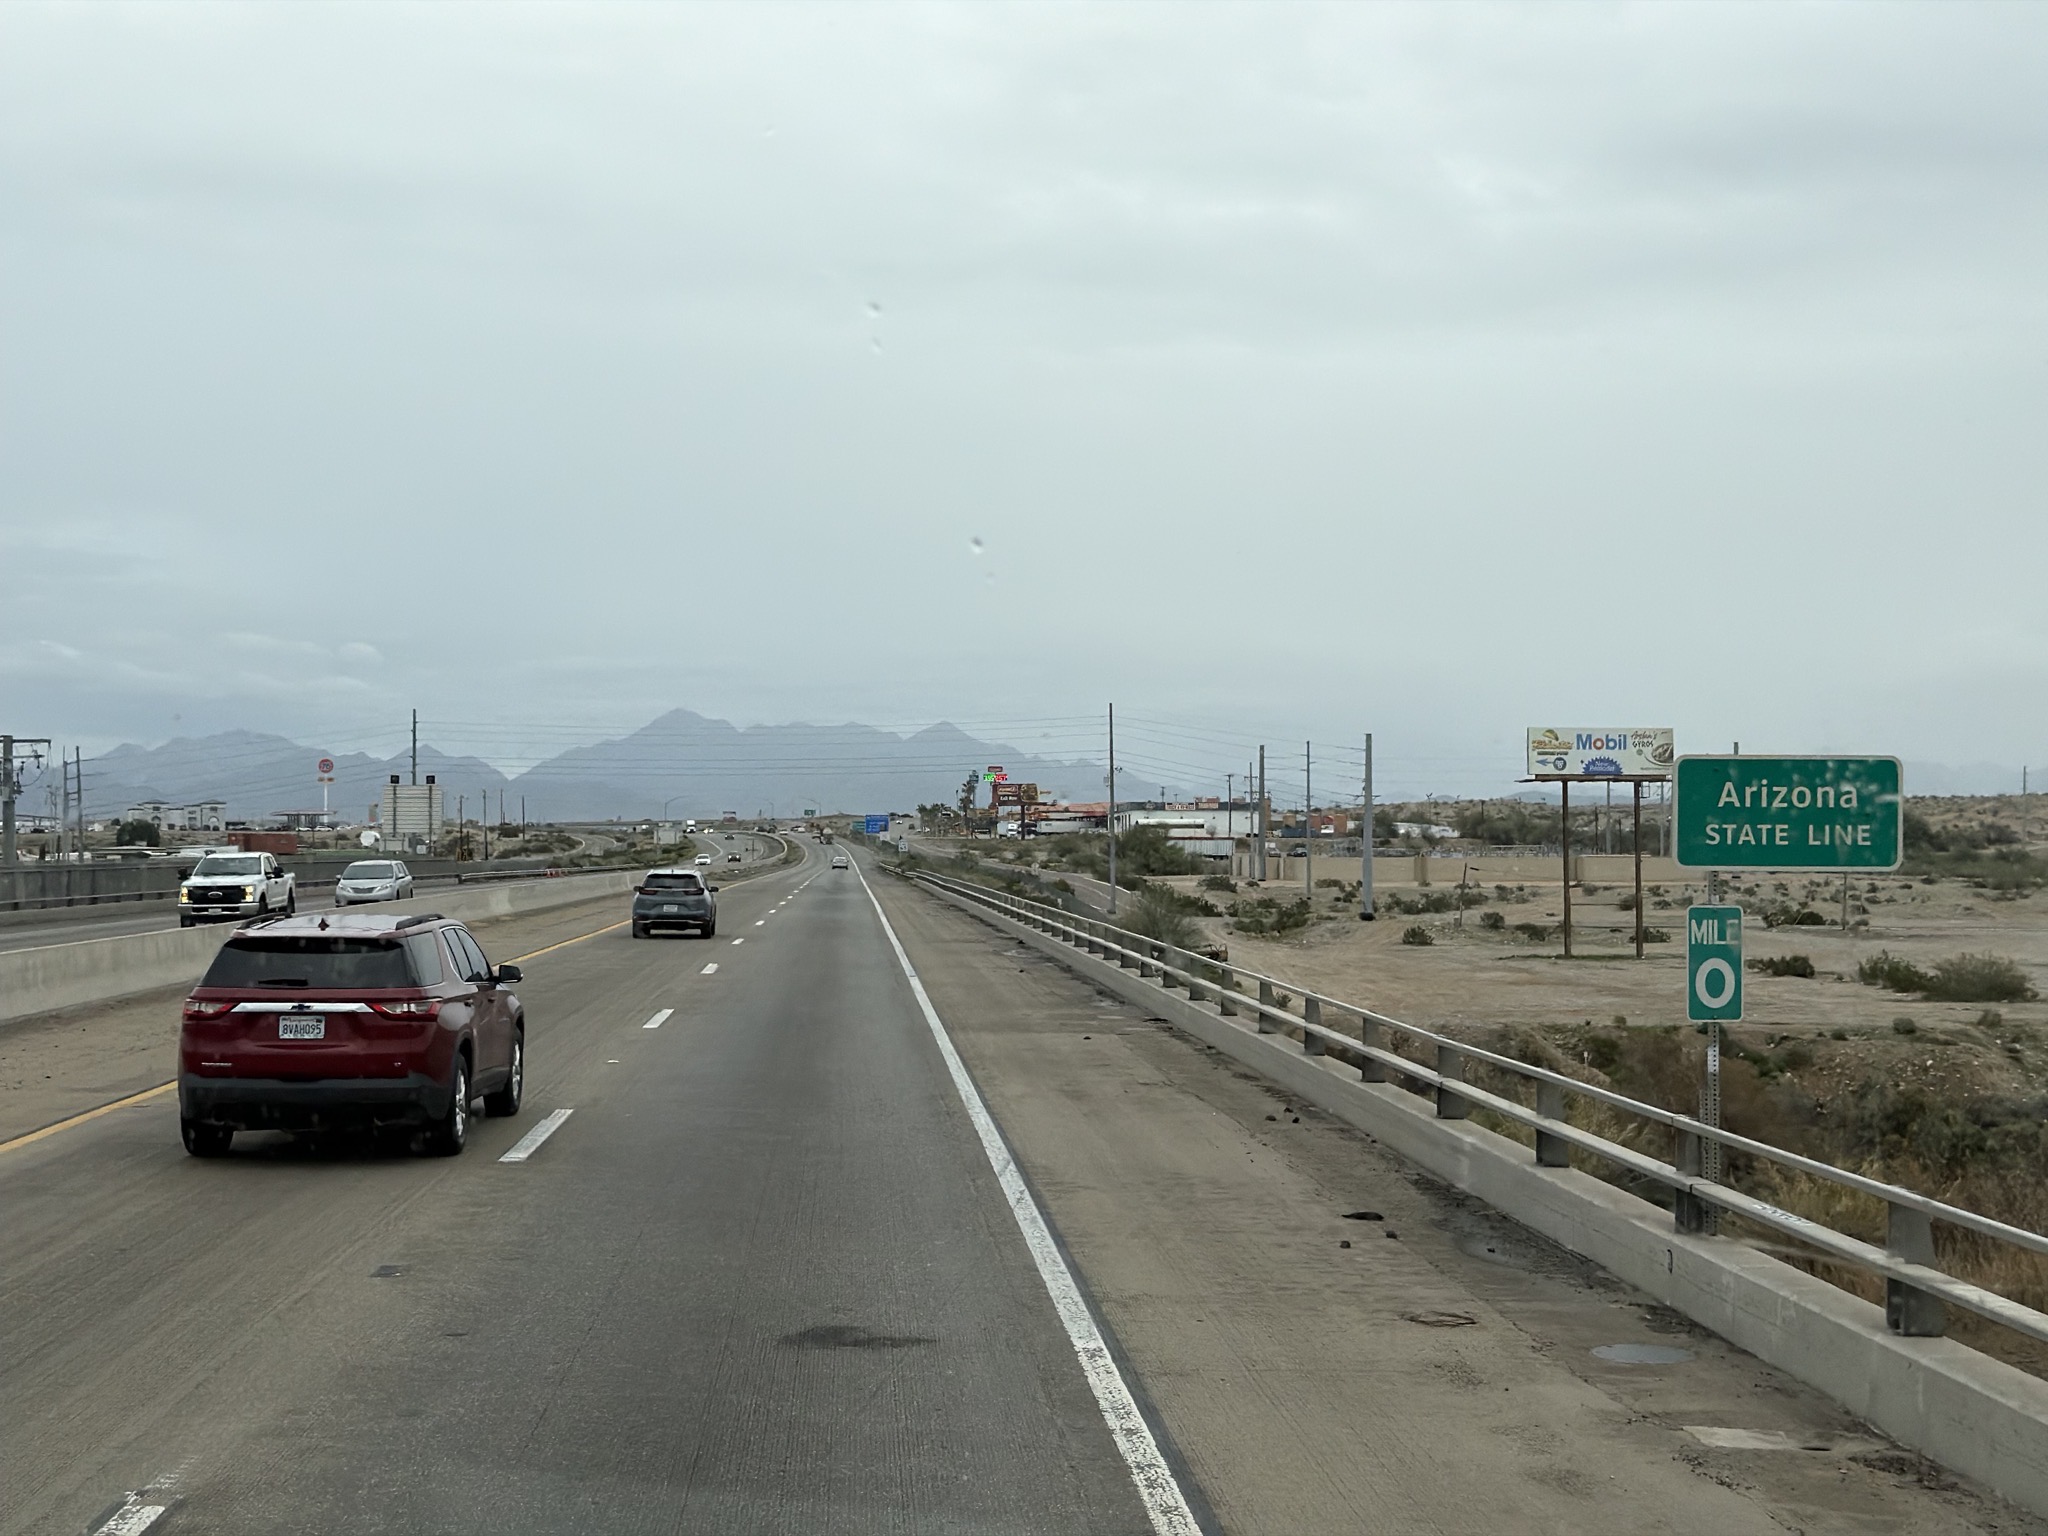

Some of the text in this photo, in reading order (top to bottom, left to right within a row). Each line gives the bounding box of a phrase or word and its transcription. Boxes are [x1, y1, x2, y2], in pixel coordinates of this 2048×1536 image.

[1576, 734, 1627, 750] Mobil
[1632, 740, 1654, 748] GYROS
[1717, 779, 1858, 808] Arizona
[1705, 823, 1872, 846] STATE LINE
[1691, 919, 1739, 945] MILE
[283, 1023, 322, 1035] 8VAH095
